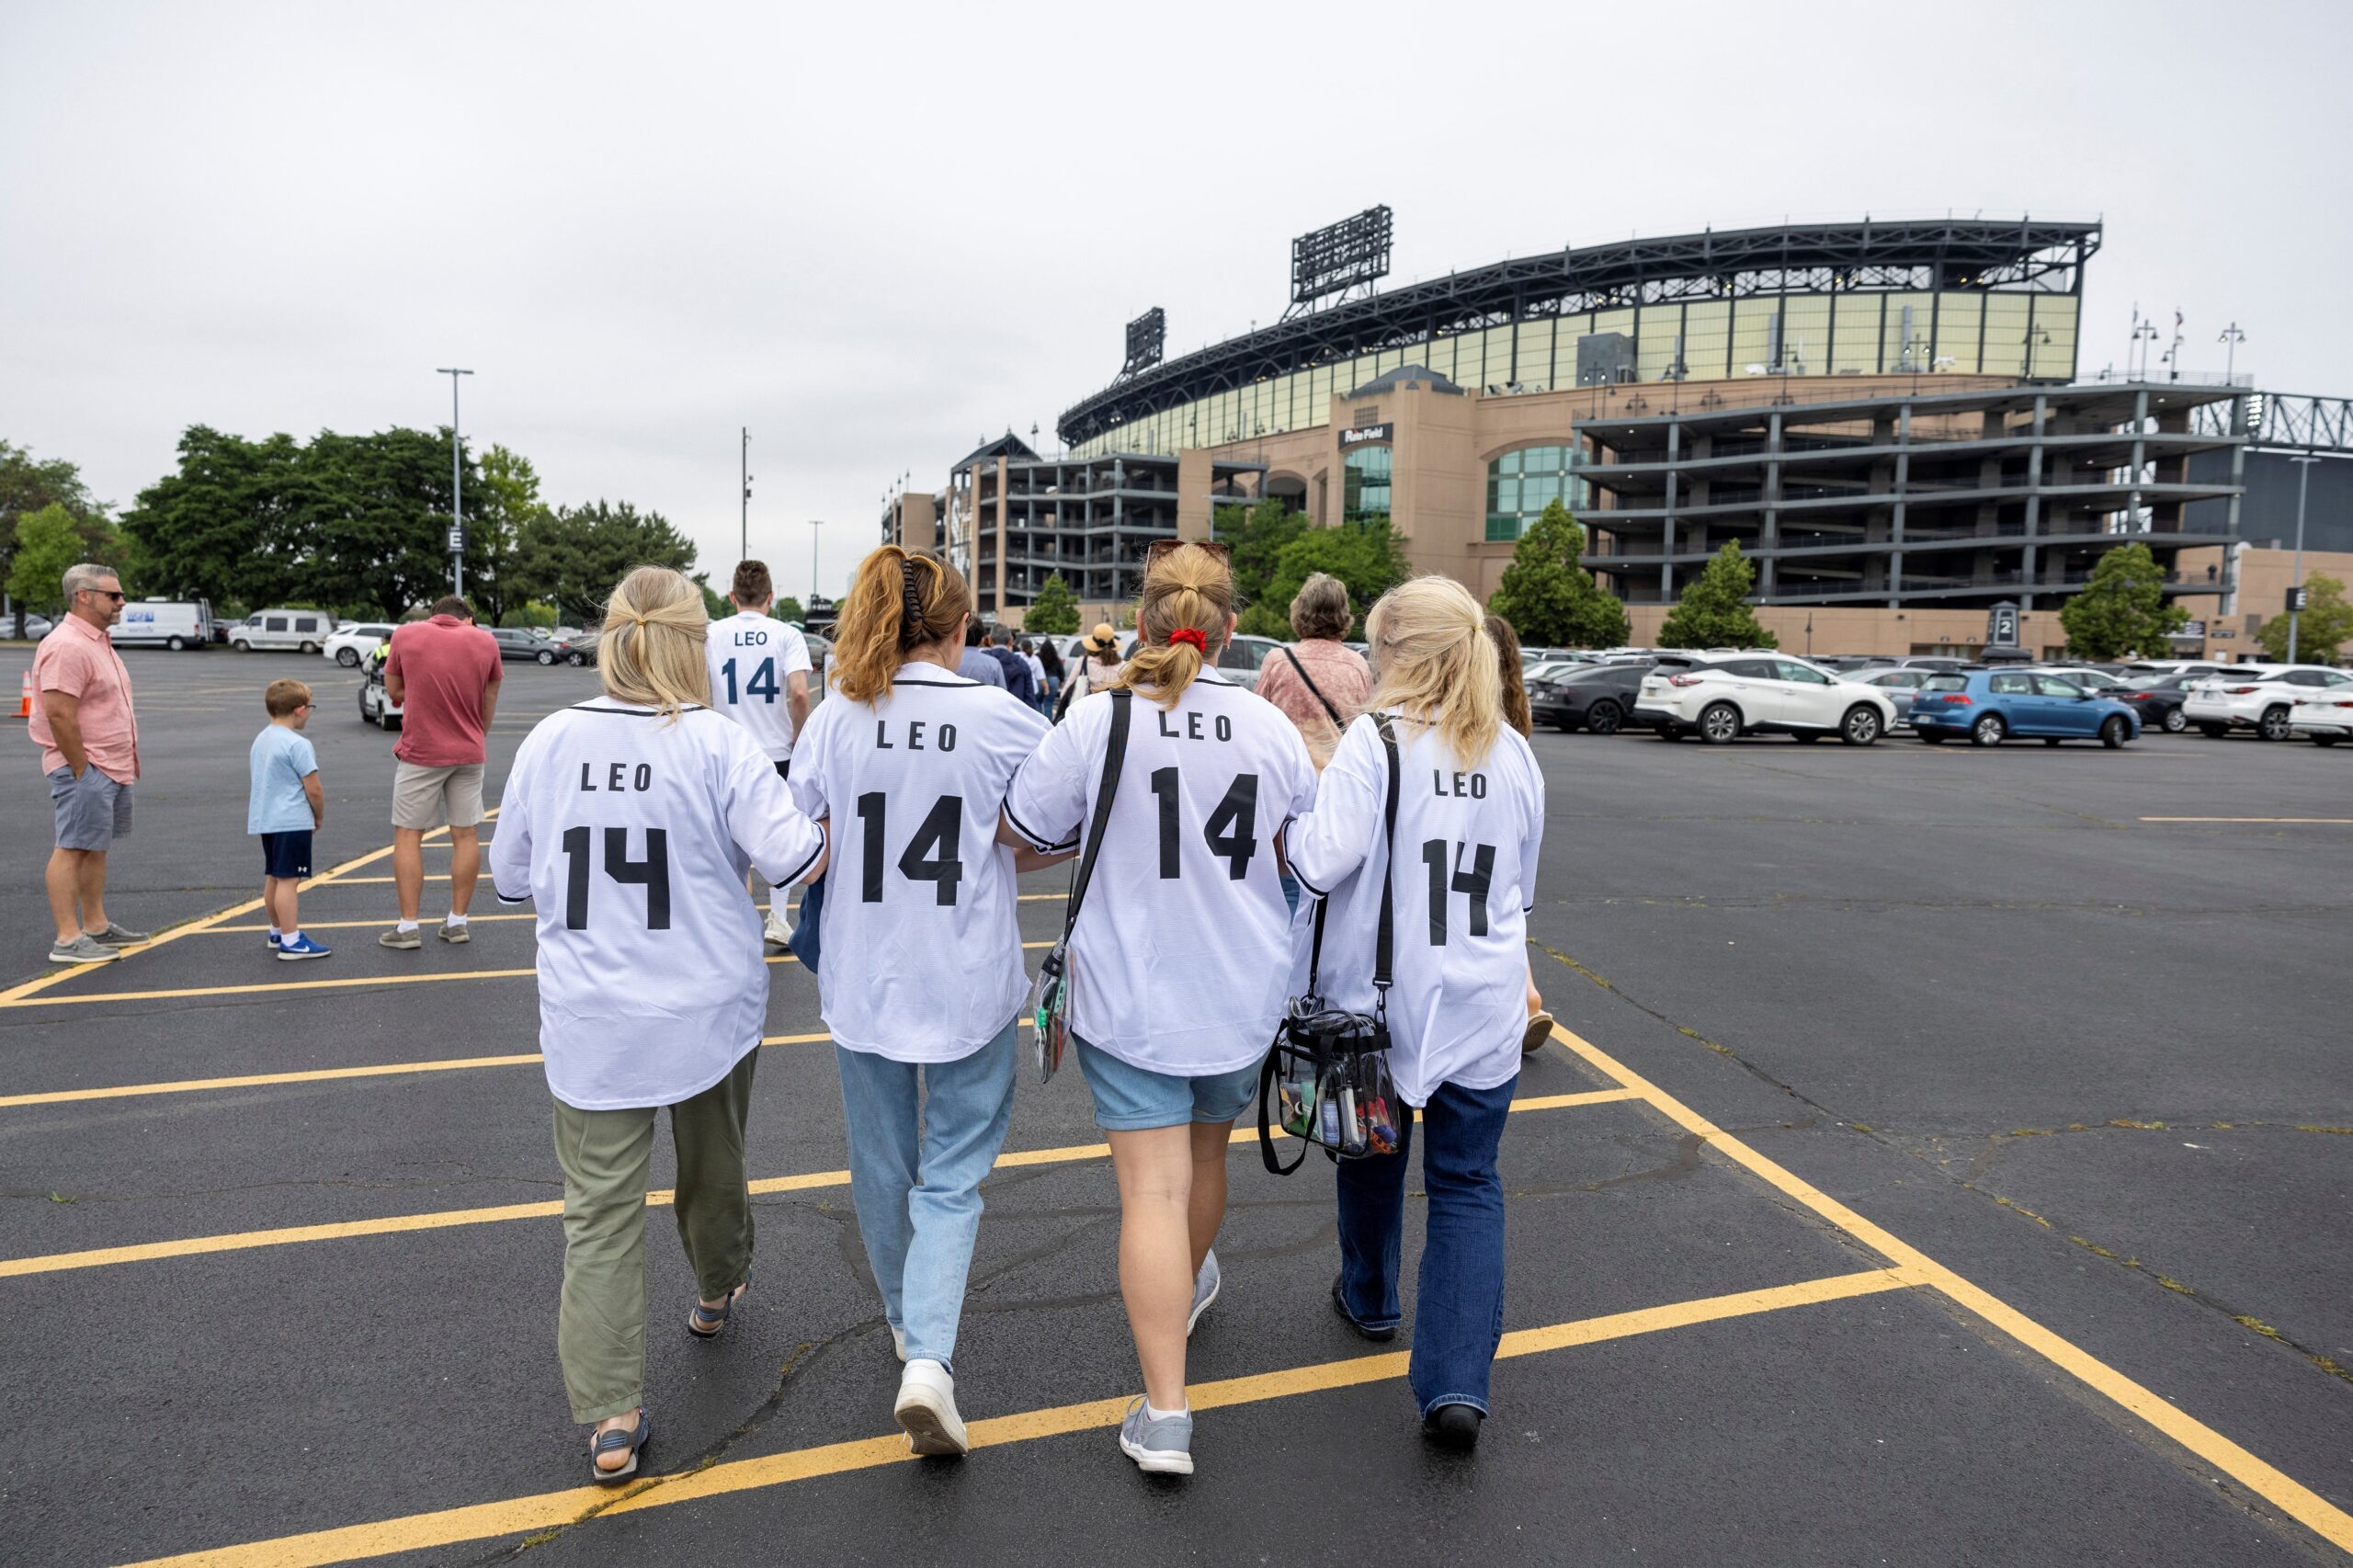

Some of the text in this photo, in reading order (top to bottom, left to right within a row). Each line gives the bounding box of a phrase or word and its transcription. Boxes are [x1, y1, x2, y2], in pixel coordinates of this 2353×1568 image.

[449, 531, 462, 547] E
[734, 631, 767, 646] LEO
[1999, 620, 2012, 634] 2
[722, 657, 780, 705] 14
[876, 720, 957, 752] LEO
[1158, 710, 1232, 742] LEO
[581, 762, 652, 792] LEO
[1434, 769, 1486, 800] LEO
[1151, 767, 1258, 881] 14
[857, 791, 963, 906] 14
[562, 825, 671, 930] 14
[1422, 838, 1496, 947] 14
